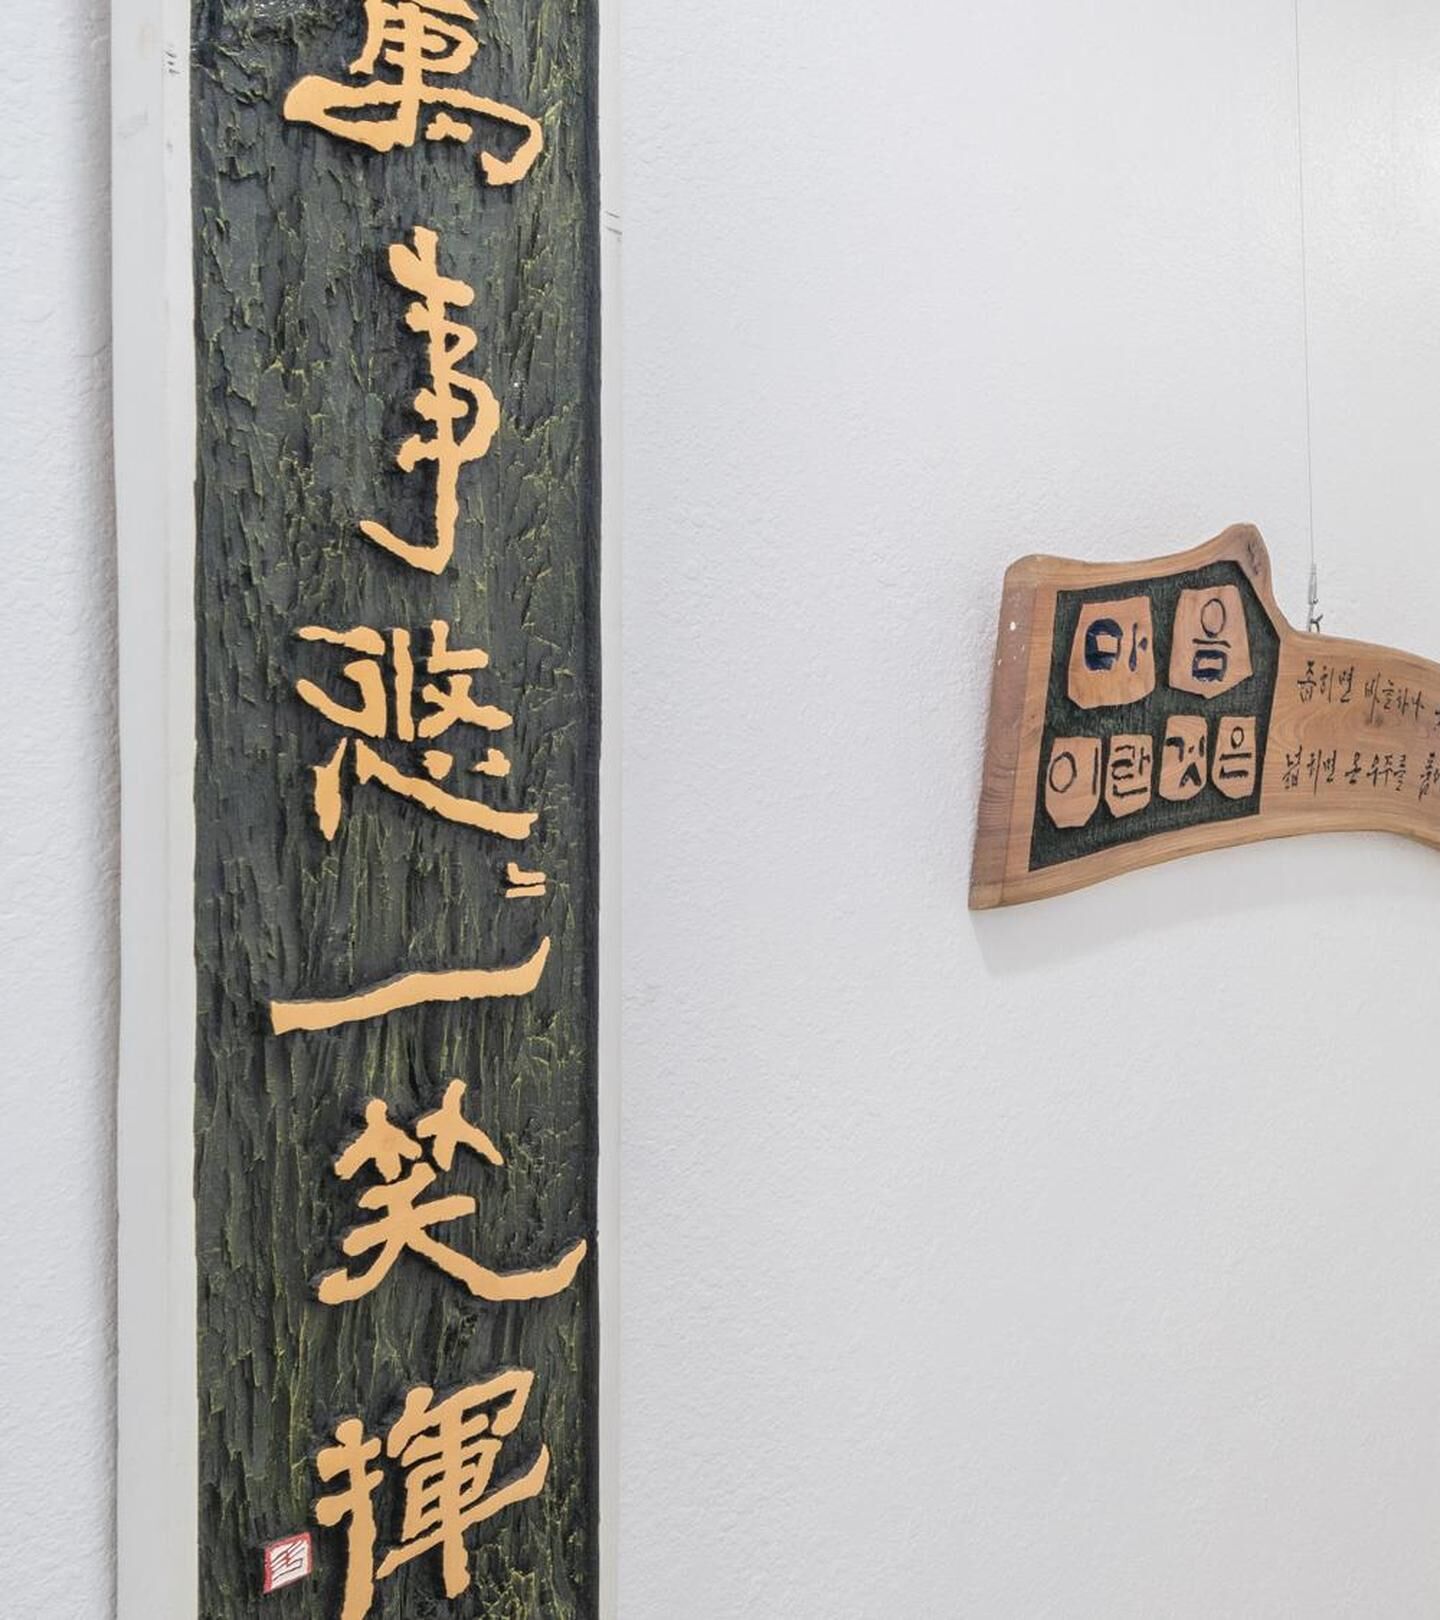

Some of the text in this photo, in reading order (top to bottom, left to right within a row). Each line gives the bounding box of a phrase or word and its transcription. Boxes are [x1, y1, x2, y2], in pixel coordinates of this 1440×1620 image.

[1084, 598, 1232, 682] 마음
[1297, 661, 1354, 704] 좁히면
[1282, 745, 1336, 796] 넓히면
